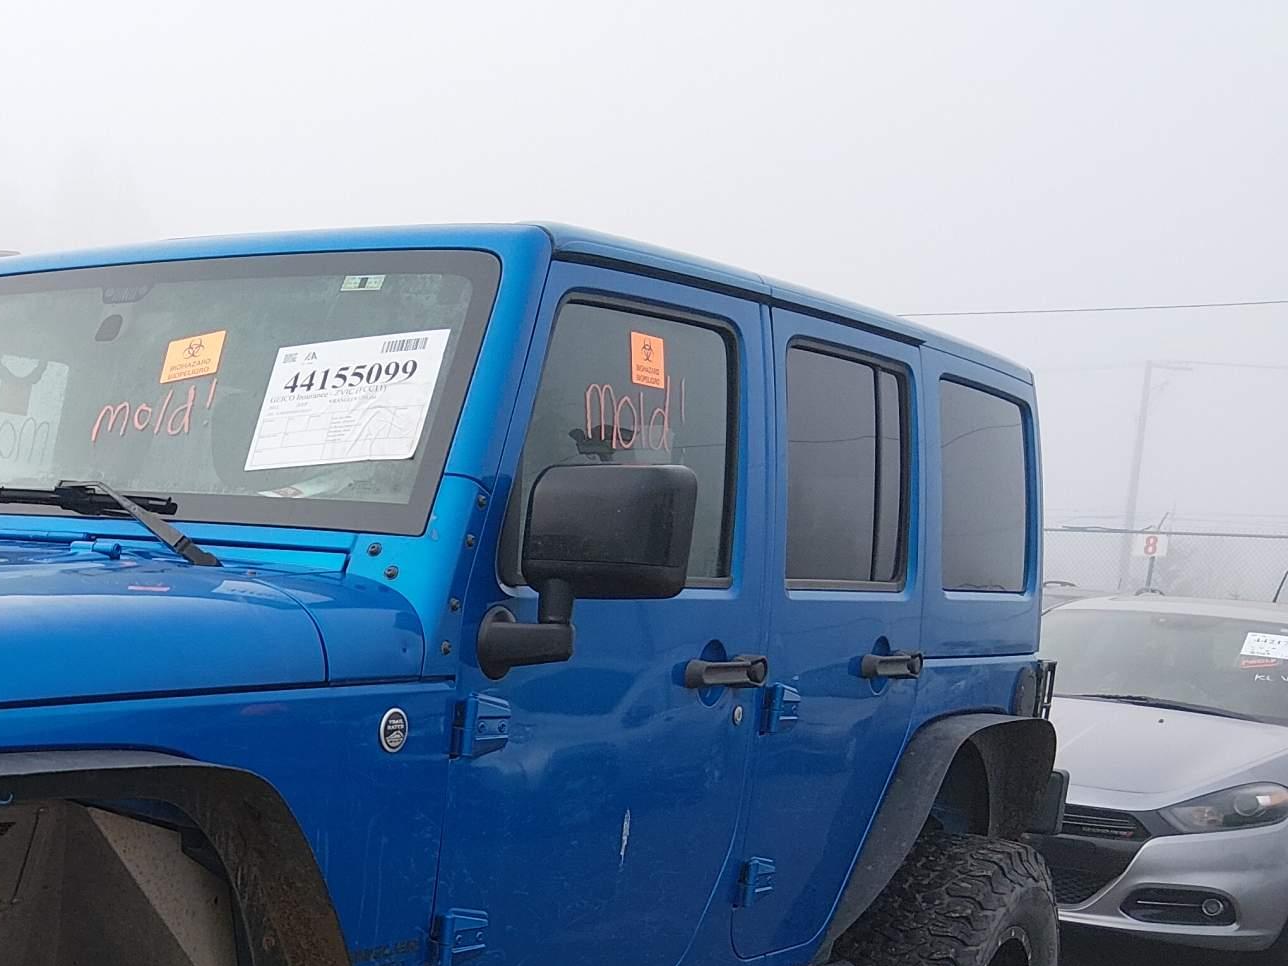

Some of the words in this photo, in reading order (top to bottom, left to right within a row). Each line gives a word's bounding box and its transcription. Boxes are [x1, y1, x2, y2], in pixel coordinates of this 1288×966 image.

[283, 359, 418, 393] 44155099
[90, 376, 218, 444] mold!
[1143, 534, 1159, 556] 8
